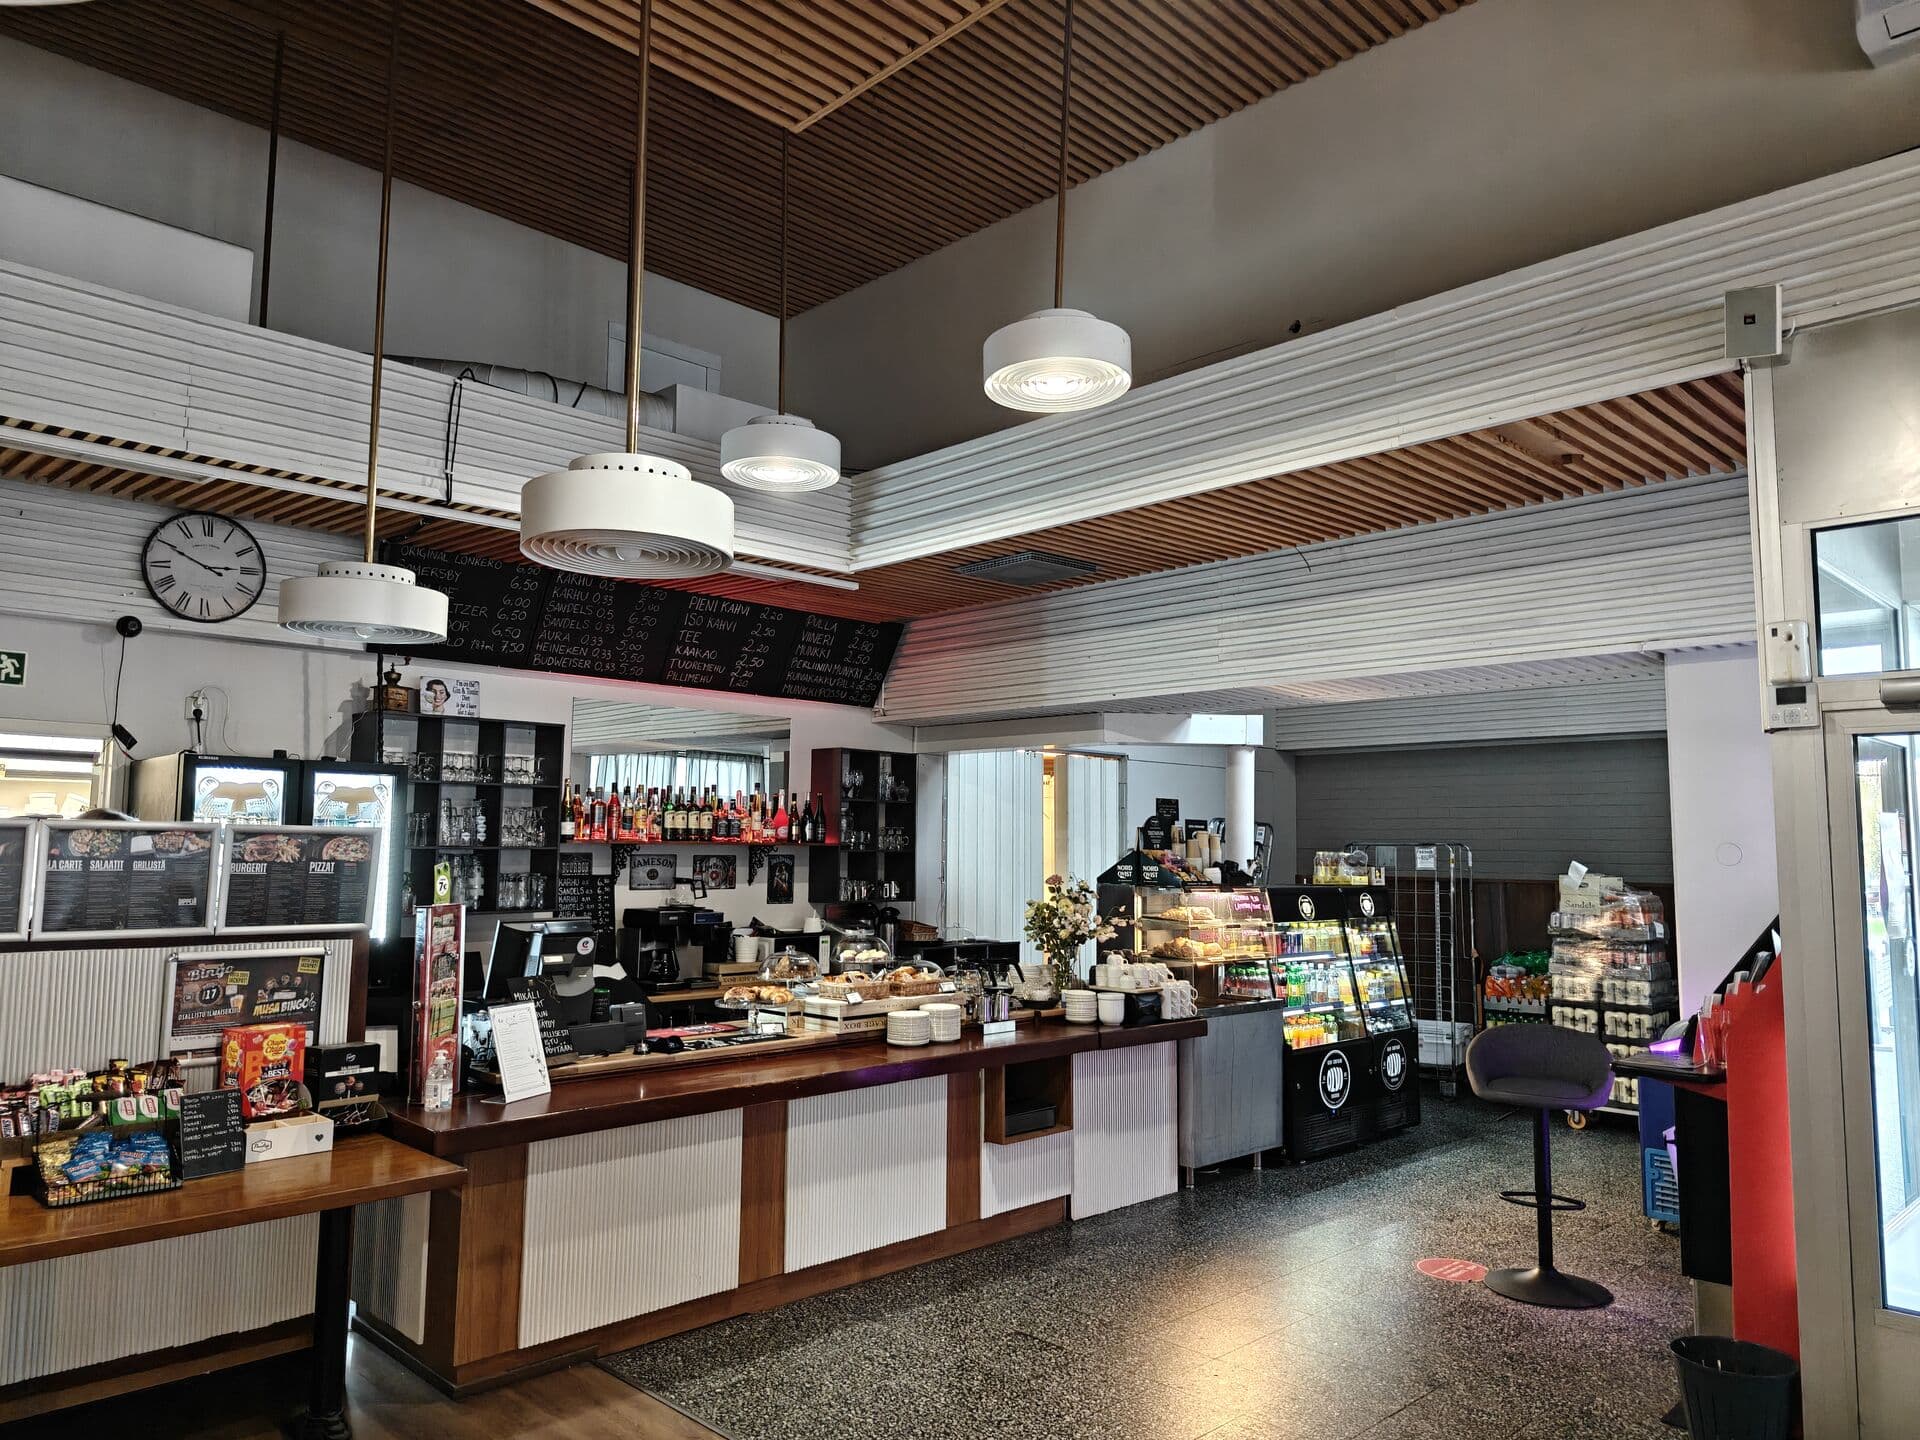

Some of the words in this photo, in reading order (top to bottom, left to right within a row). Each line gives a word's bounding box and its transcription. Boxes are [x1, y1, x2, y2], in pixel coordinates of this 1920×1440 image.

[401, 545, 448, 562] ORIGINAL
[455, 554, 503, 570] LONKERO
[555, 571, 594, 587] KARHU
[552, 586, 590, 601] KARHU
[448, 604, 488, 619] TZER
[546, 600, 593, 615] SANDELS
[689, 596, 718, 613] PIENI
[720, 601, 750, 617] KAHVI
[543, 614, 590, 630] SANDELS
[684, 612, 704, 626] ISO
[707, 618, 737, 632] KAHVI
[806, 614, 839, 633] PULLA
[538, 629, 570, 642] AURA
[680, 629, 702, 643] TEE
[801, 629, 835, 646] VIINERI
[536, 641, 588, 656] HEINEKEN
[675, 645, 718, 660] KAAKAO
[795, 644, 832, 659] MUNKKI
[533, 653, 592, 669] BUDWEISER
[669, 658, 726, 674] TUOREMEHU
[666, 670, 713, 683] PILLIMEHU
[59, 859, 83, 870] CARTE
[89, 860, 124, 870] SALAATIT
[132, 859, 166, 870] GRILLISTÄ
[231, 862, 267, 873] BURGERIT
[309, 861, 335, 873] PIZZAT
[631, 856, 675, 870] JAMESON
[558, 878, 580, 887] KARHU
[558, 887, 585, 896] SANDELS
[558, 903, 585, 911] SANDELS
[188, 963, 235, 981] Bingo
[513, 988, 540, 1001] MIKÄLI
[253, 1003, 280, 1016] MUSA
[281, 998, 309, 1011] BINGO
[268, 1068, 284, 1077] BEST
